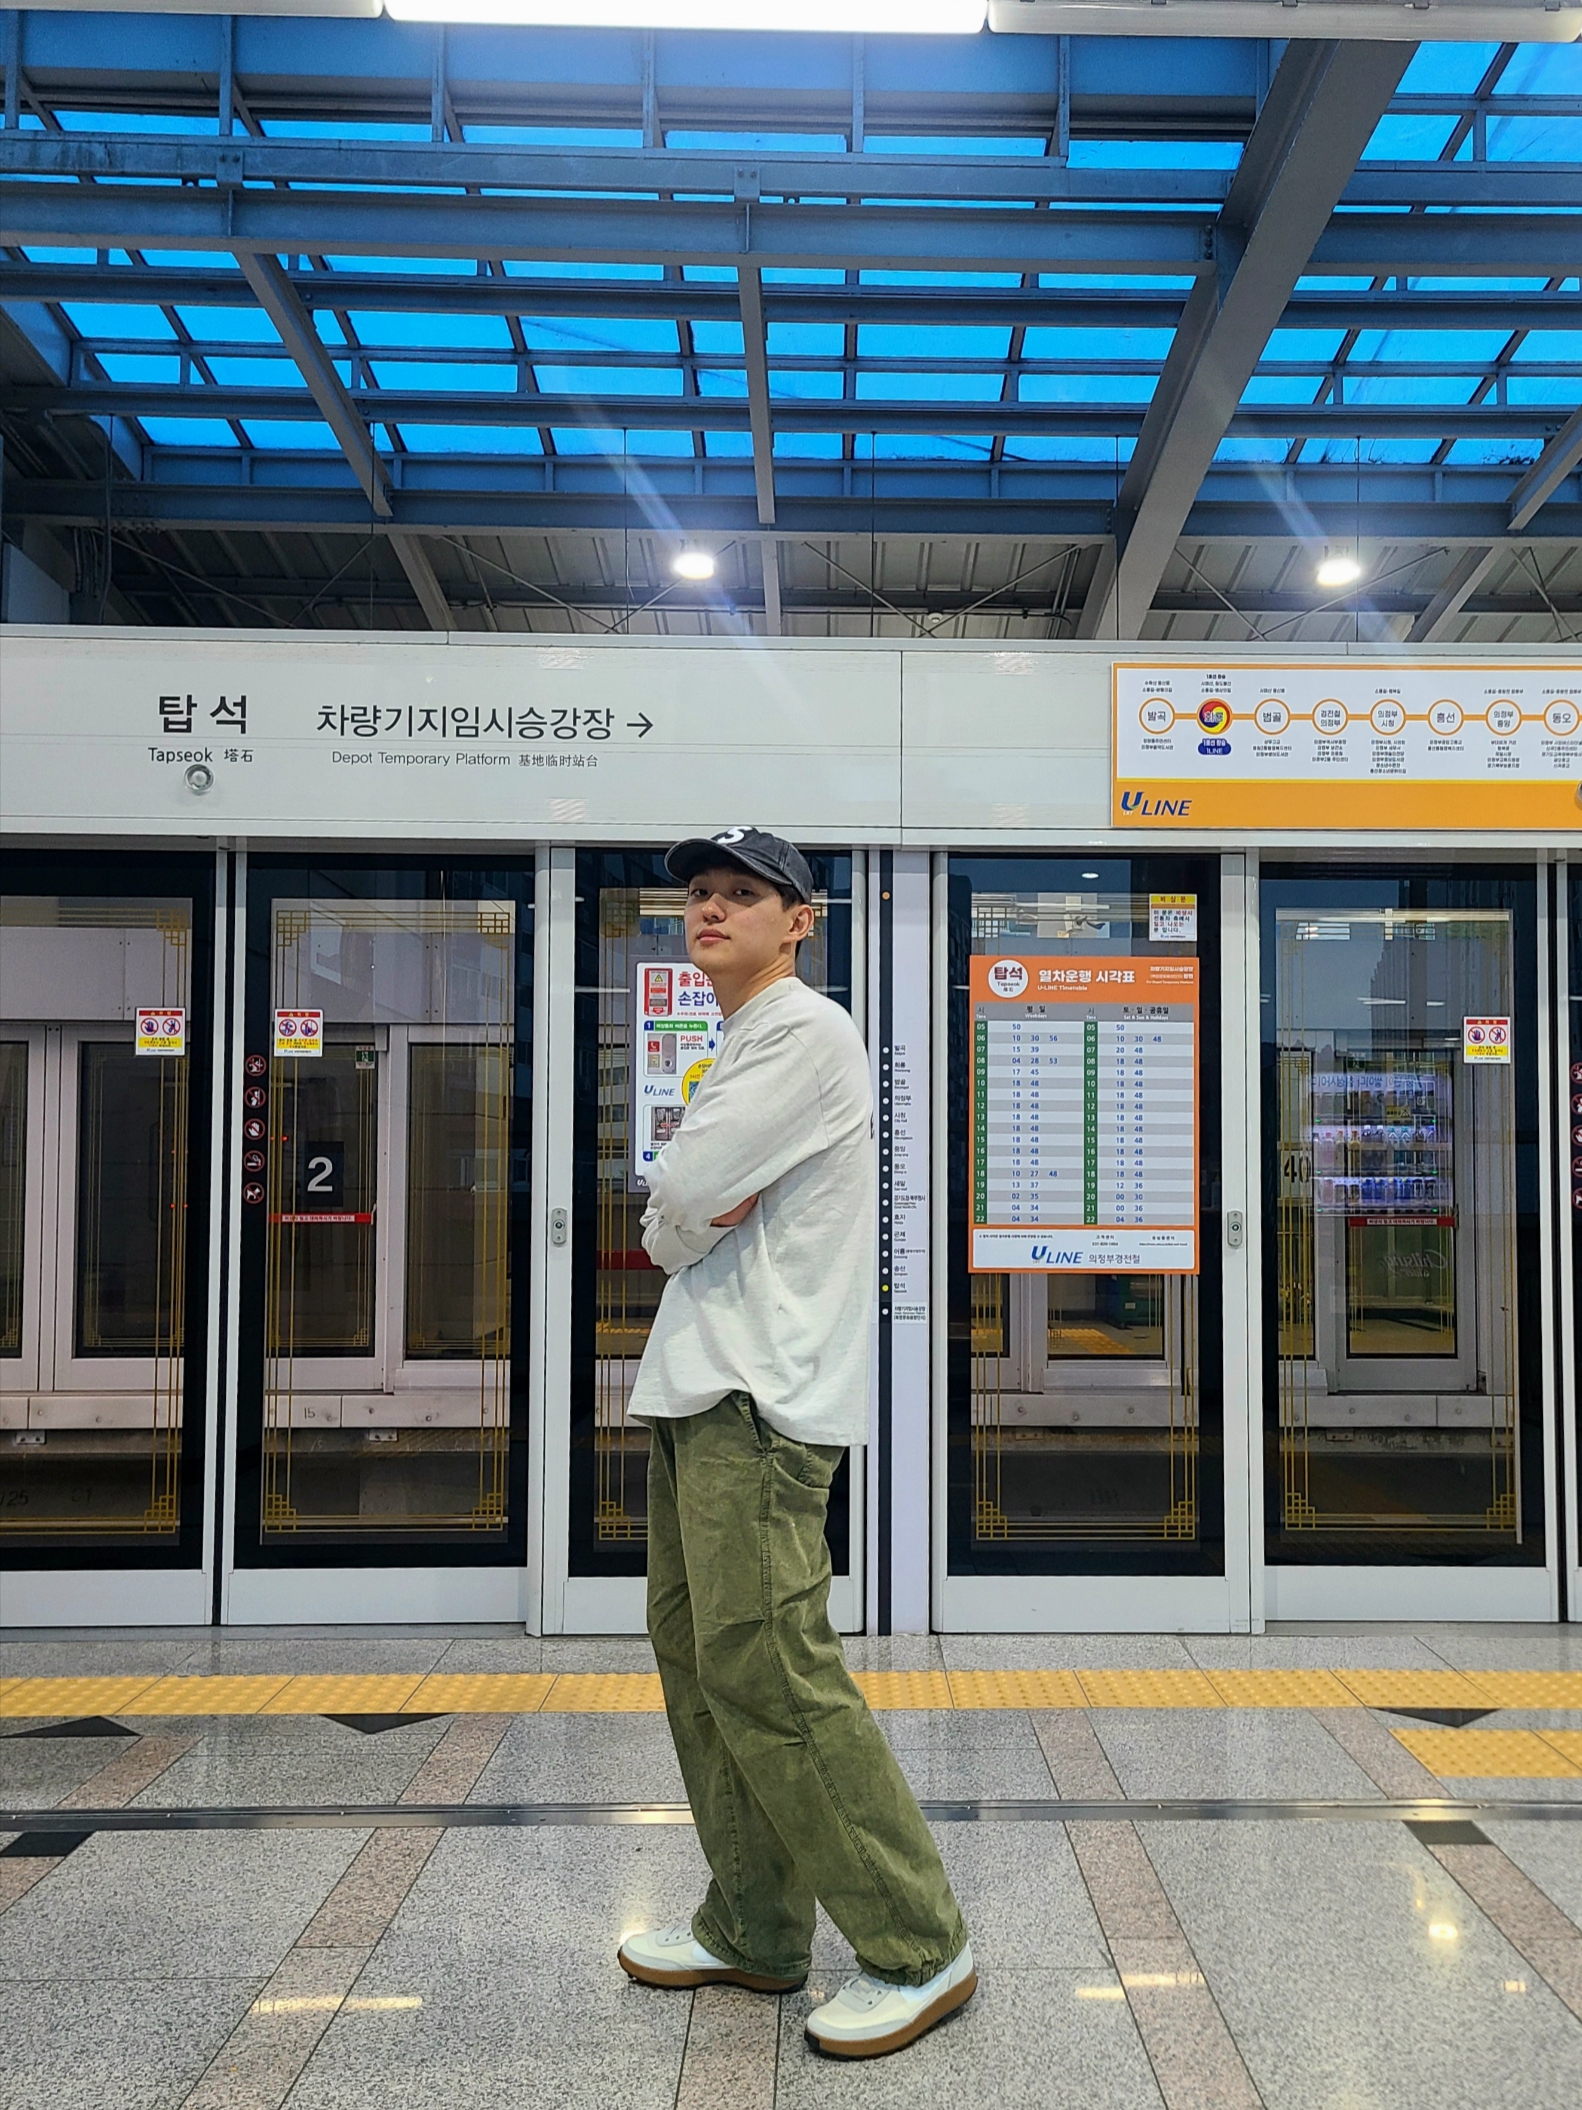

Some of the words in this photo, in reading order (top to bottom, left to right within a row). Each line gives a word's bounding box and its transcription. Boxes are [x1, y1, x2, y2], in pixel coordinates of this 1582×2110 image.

[1147, 711, 1167, 722] 발곡
[1377, 710, 1398, 719] 의정부
[1435, 712, 1456, 724] 흥선
[1493, 711, 1514, 719] 의정부
[1552, 712, 1572, 724] 동오
[316, 704, 615, 740] 차량기지임시승강장
[1320, 719, 1341, 728] 의정부
[1381, 719, 1395, 728] 시청
[147, 747, 213, 765] Tapseok
[223, 748, 254, 764] 塔石
[332, 750, 373, 767] Depot
[377, 750, 451, 767] Temporary
[455, 751, 511, 767] Platform
[518, 753, 599, 768] 基地临时站台
[717, 826, 753, 844] S
[994, 967, 1023, 980] 탑석
[1039, 969, 1091, 983] 열차운행
[1095, 969, 1135, 983] 시각표
[976, 1023, 986, 1031] 05
[1086, 1024, 1096, 1032] 05
[976, 1034, 986, 1042] 06
[976, 1057, 985, 1065] 08
[976, 1068, 985, 1076] 09
[976, 1079, 985, 1087] 10
[976, 1091, 985, 1099] 11
[976, 1102, 985, 1110] 12
[976, 1170, 985, 1178] 18
[1284, 1155, 1311, 1183] 40
[307, 1156, 333, 1193] 2
[976, 1181, 985, 1189] 19
[976, 1192, 985, 1200] 20
[976, 1215, 985, 1223] 22
[1088, 1254, 1140, 1264] 의정부경전철
[304, 1407, 316, 1420] 15
